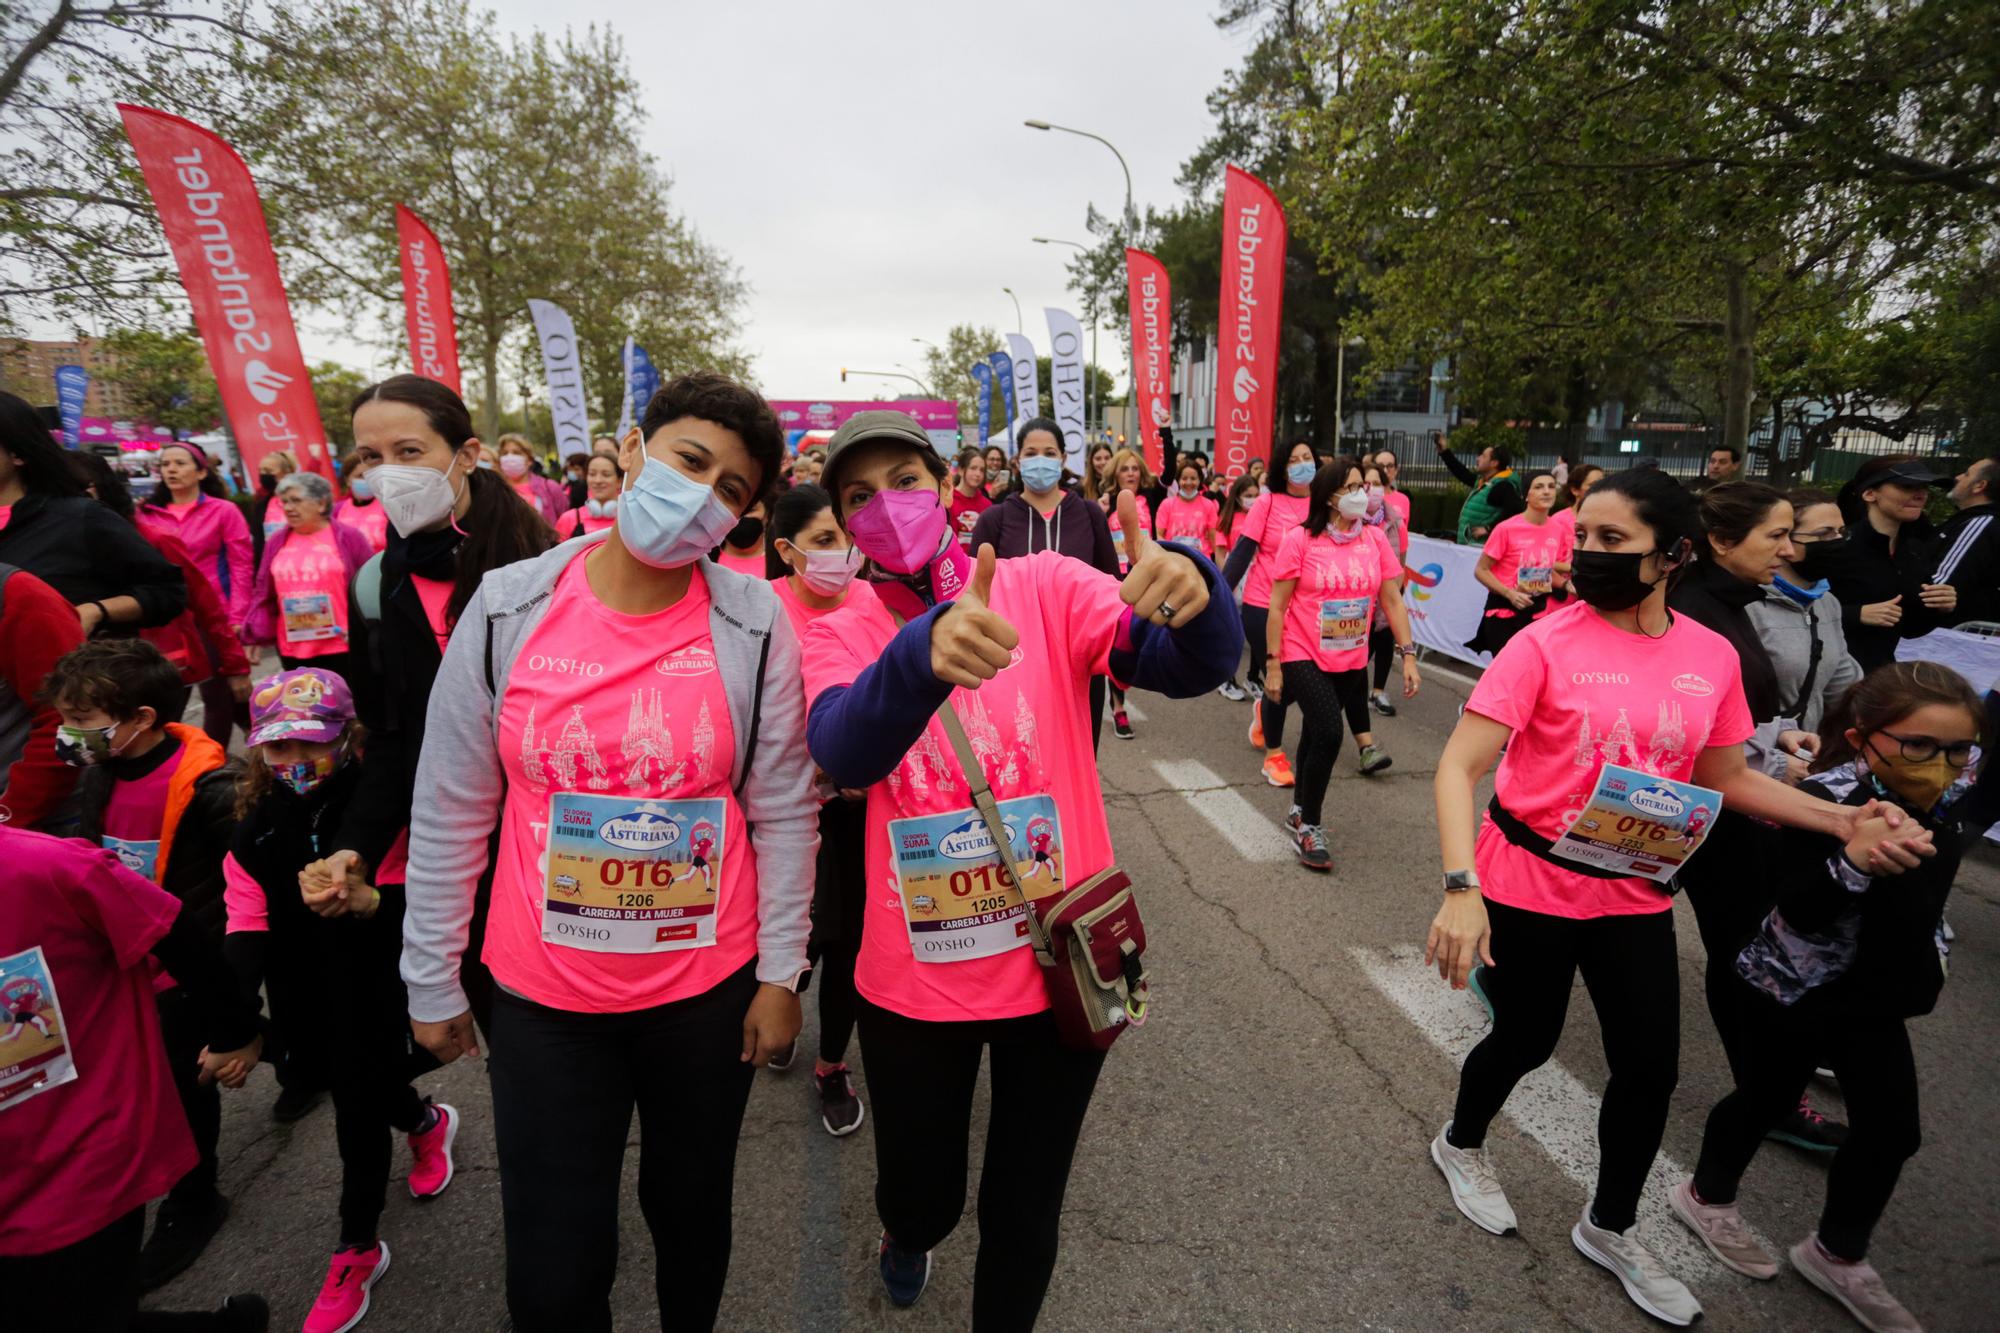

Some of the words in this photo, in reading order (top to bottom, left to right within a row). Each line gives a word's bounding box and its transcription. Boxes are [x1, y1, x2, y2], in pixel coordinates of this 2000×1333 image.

[941, 576, 961, 590] SCA
[1339, 619, 1360, 629] 016
[528, 654, 604, 678] OYSHO
[662, 660, 714, 671] ASTURIANA
[1572, 672, 1630, 685] OYSHO
[1632, 793, 1680, 814] ASTURIANA
[563, 815, 592, 826] SUMA
[1616, 816, 1669, 841] 016
[605, 825, 675, 841] ASTURIANA
[904, 839, 930, 848] SUMA
[1620, 838, 1645, 849] 1233
[1566, 844, 1604, 860] OYSHO
[600, 858, 672, 887] 016
[950, 863, 1015, 896] 016
[617, 894, 654, 906] 1206
[971, 896, 1006, 913] 1205
[579, 906, 621, 919] CARRERA
[625, 908, 637, 919] DE
[639, 908, 651, 919] LA
[654, 907, 684, 919] MUJER
[940, 917, 981, 929] CARRERA
[983, 914, 994, 923] DE
[996, 911, 1007, 920] LA
[557, 922, 610, 941] OYSHO
[925, 936, 976, 952] OYSHO
